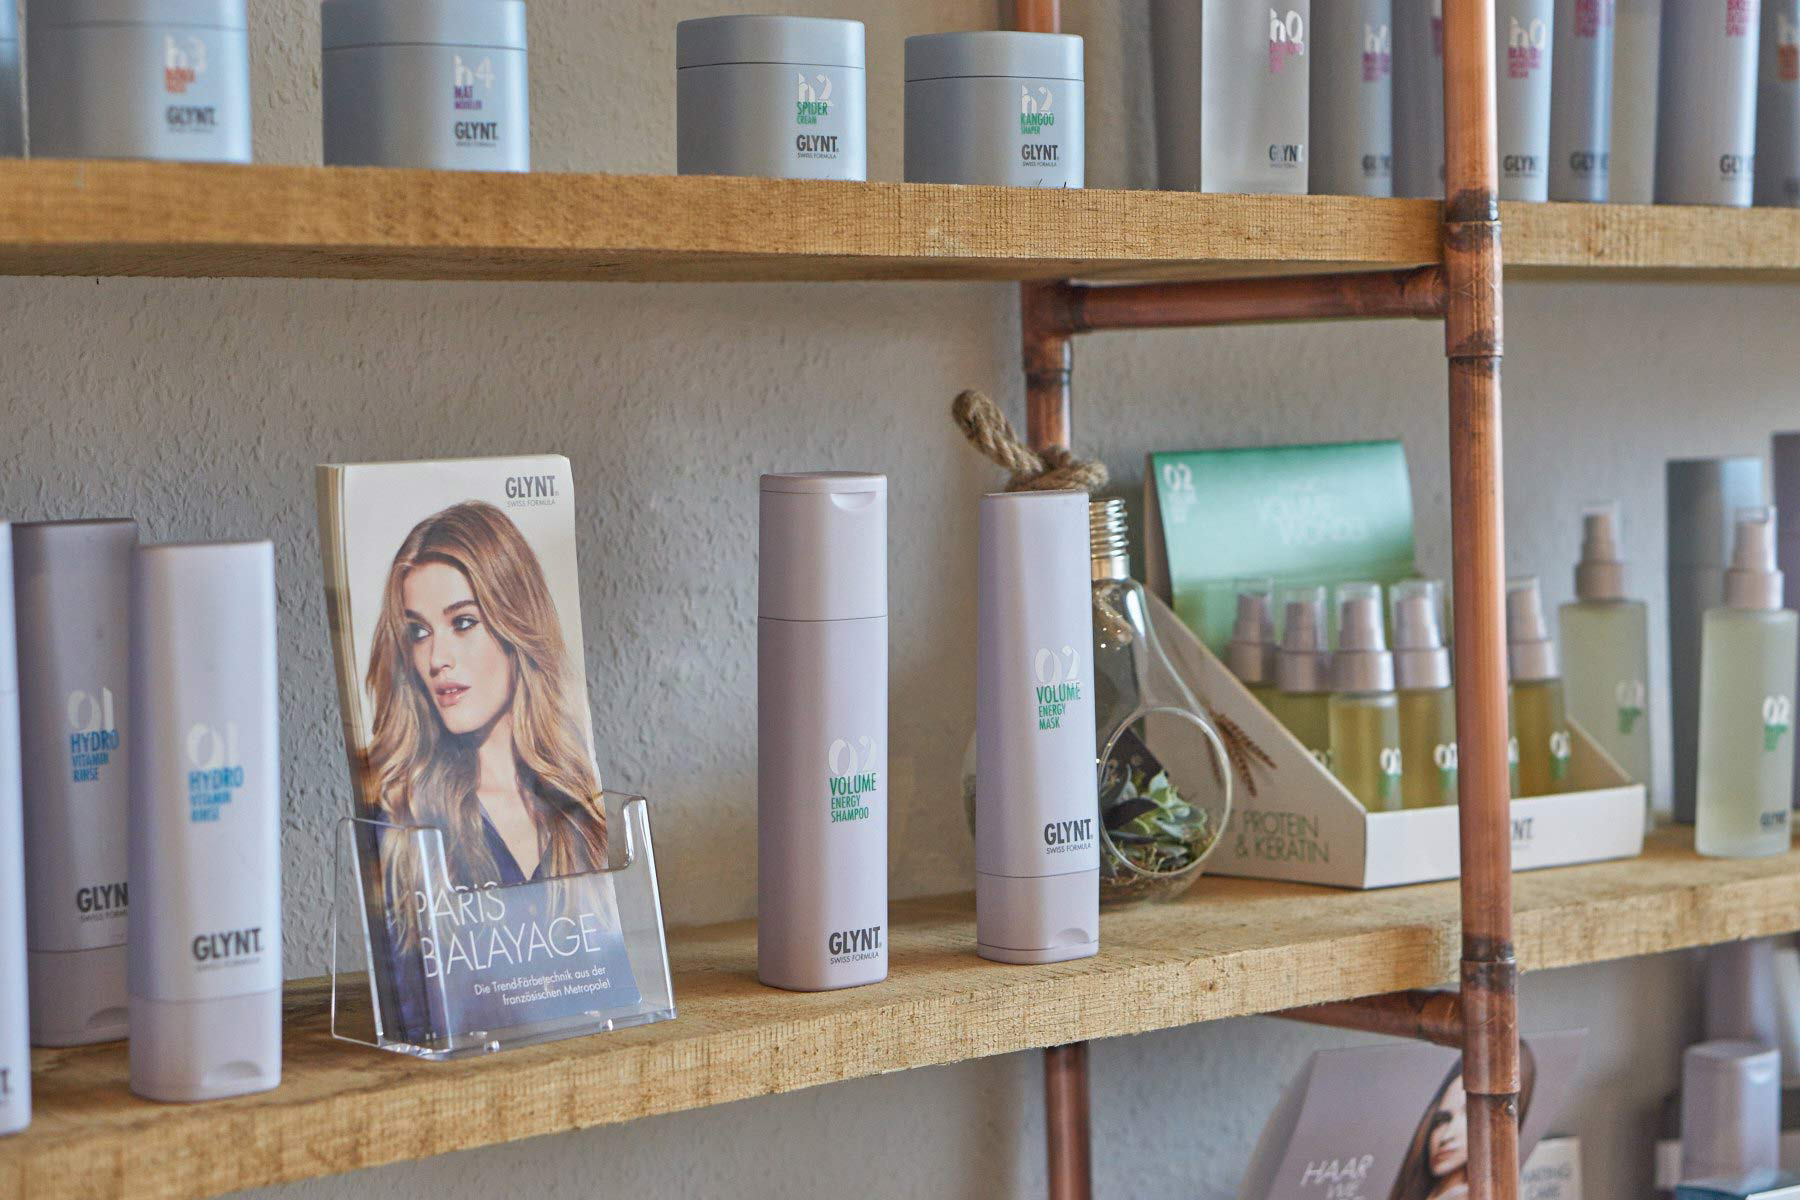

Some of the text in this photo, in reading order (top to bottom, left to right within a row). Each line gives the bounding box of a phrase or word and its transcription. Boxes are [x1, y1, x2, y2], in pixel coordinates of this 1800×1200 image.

[797, 101, 828, 115] SPIDER
[1021, 111, 1055, 126] KANGOO
[796, 134, 838, 153] GLYNT
[1021, 144, 1059, 161] GLYNT
[505, 474, 556, 499] GLYNT
[1036, 681, 1081, 704] VOLUME
[1038, 703, 1066, 717] ENERGY
[1039, 717, 1061, 730] MASK
[70, 729, 120, 753] HYDRO
[829, 772, 877, 796] VOLUME
[831, 795, 861, 810] ENERGY
[830, 806, 869, 823] SHAMPOO
[1043, 818, 1091, 845] GLYNT
[77, 881, 128, 913] GLYN
[414, 881, 505, 932] PARIS
[421, 912, 601, 978] BALAYAGE
[829, 925, 881, 955] GLYNT
[474, 983, 491, 996] Die
[574, 969, 590, 980] aus
[592, 965, 607, 976] der
